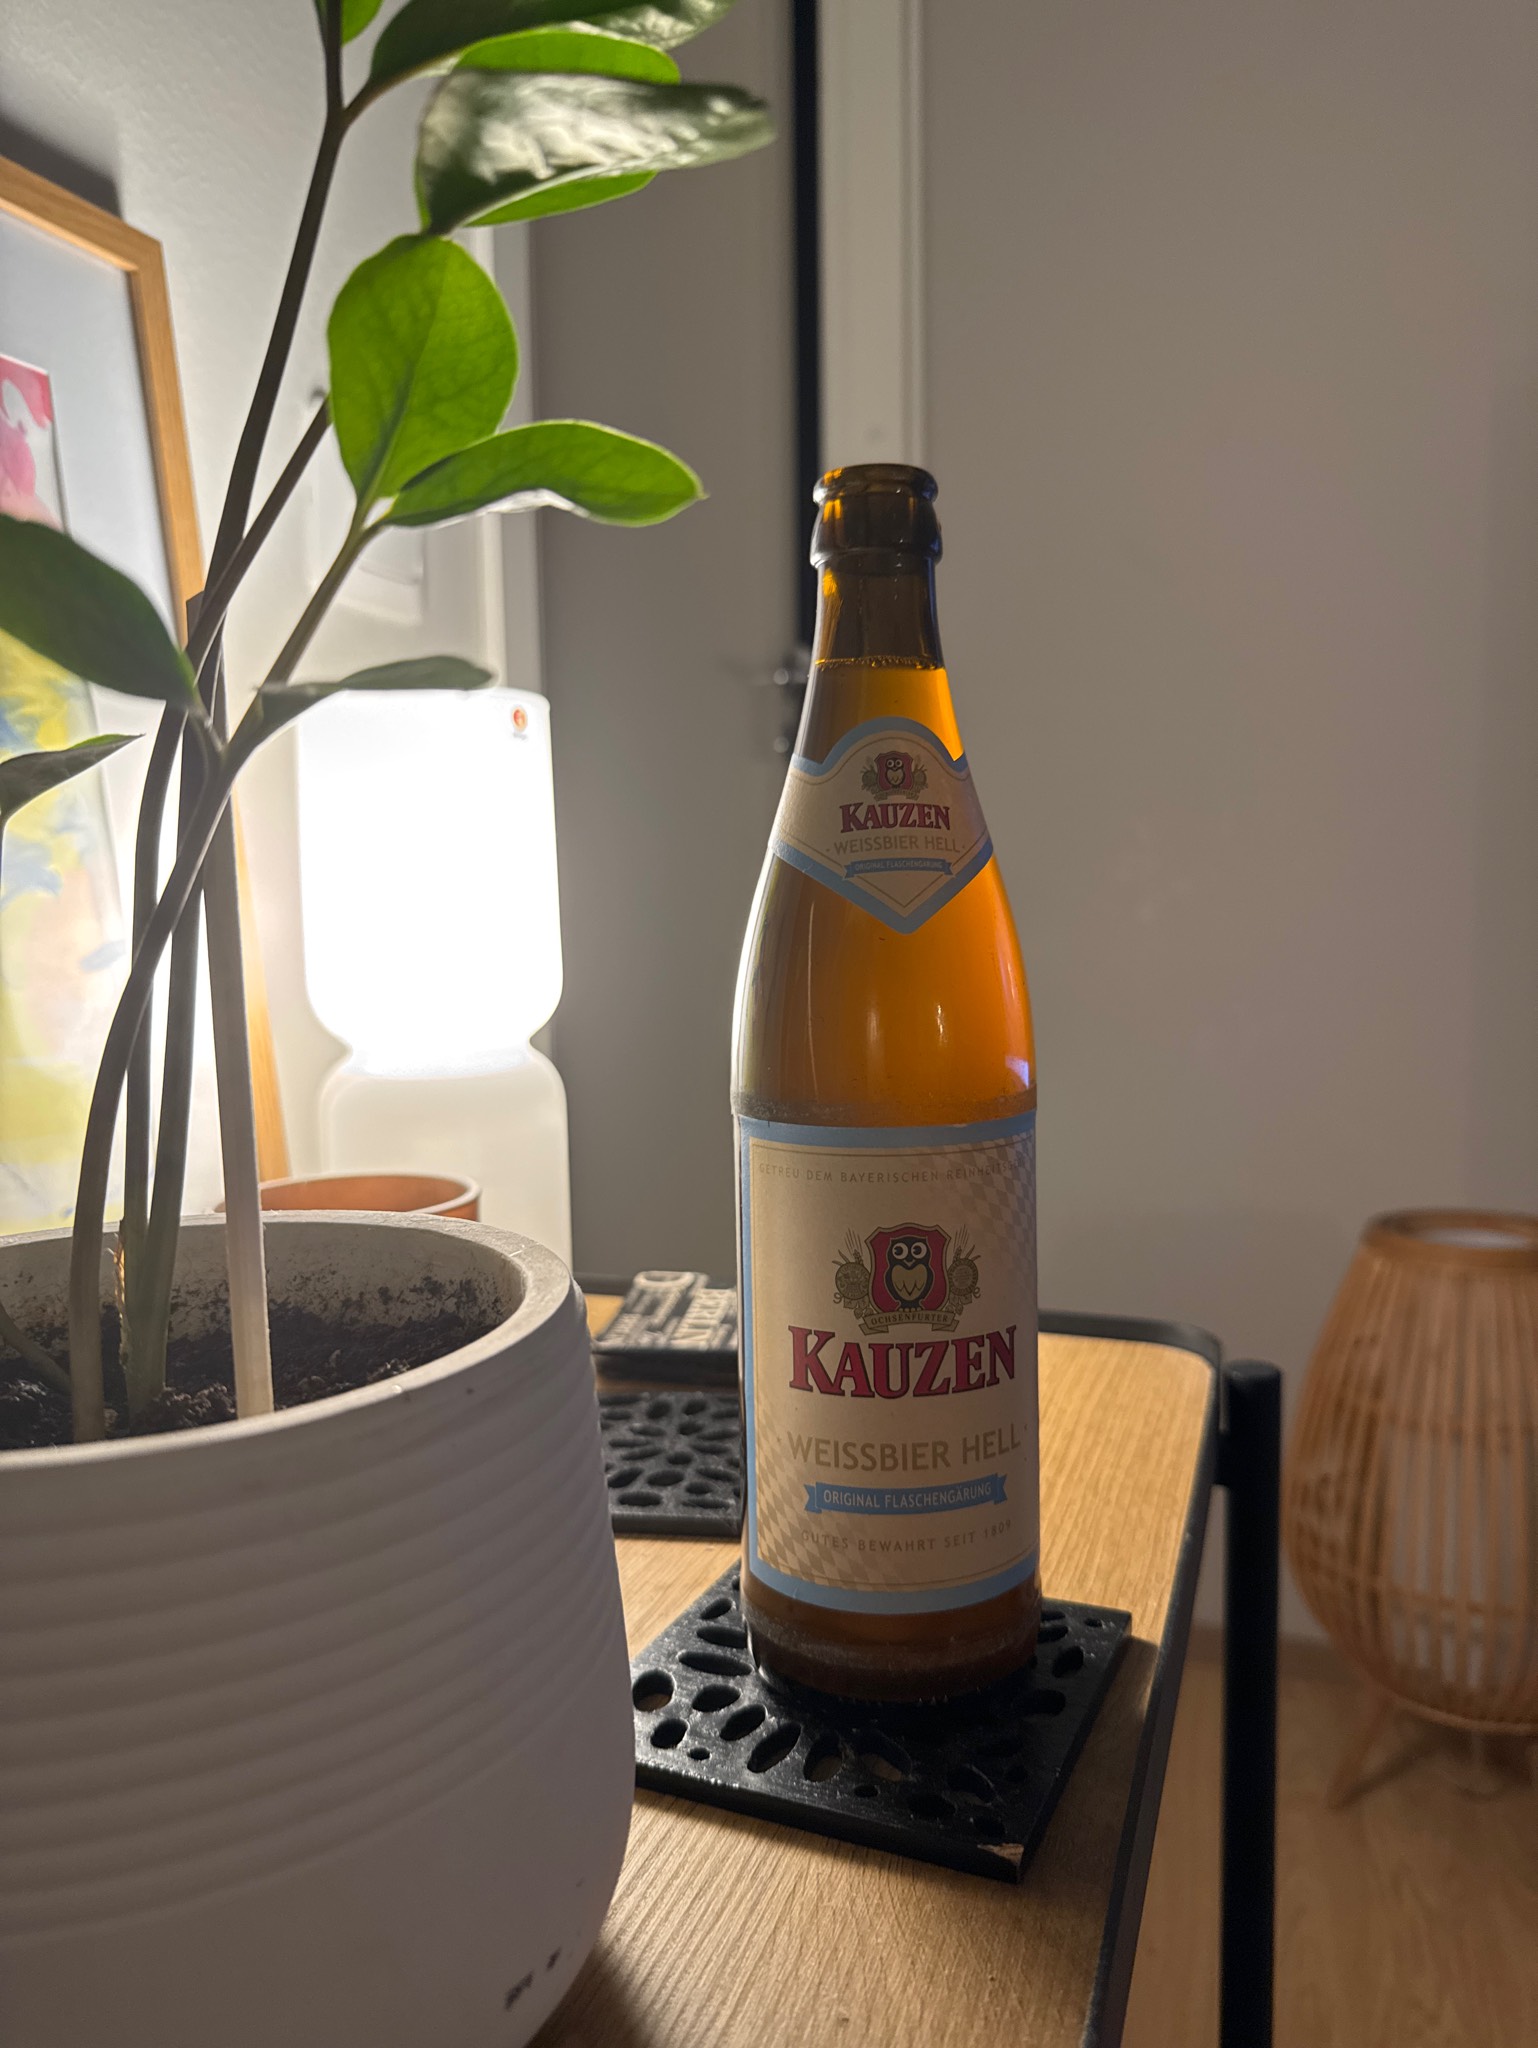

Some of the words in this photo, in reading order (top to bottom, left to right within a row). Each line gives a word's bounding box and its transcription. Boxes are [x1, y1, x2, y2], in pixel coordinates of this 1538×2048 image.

[839, 802, 951, 834] KAUZEN
[834, 836, 919, 857] WEISSBIER
[925, 836, 961, 854] HELL
[854, 861, 885, 871] ORIGINAL
[759, 1162, 800, 1179] GETREU
[806, 1169, 833, 1182] DEM
[840, 1168, 939, 1184] BAYERISCHEN
[870, 1311, 950, 1326] OCHSENFURTER
[787, 1324, 1018, 1400] KAUZEN
[787, 1430, 952, 1472] WEISSBIER
[962, 1422, 1022, 1466] HELL
[823, 1488, 881, 1509] ORIGINAL
[884, 1481, 993, 1510] FLASCHENGÄRUNG
[801, 1530, 850, 1550] GUTES
[857, 1537, 938, 1553] BEWAHRT
[944, 1531, 976, 1548] SEIT
[983, 1518, 1013, 1540] 1809
